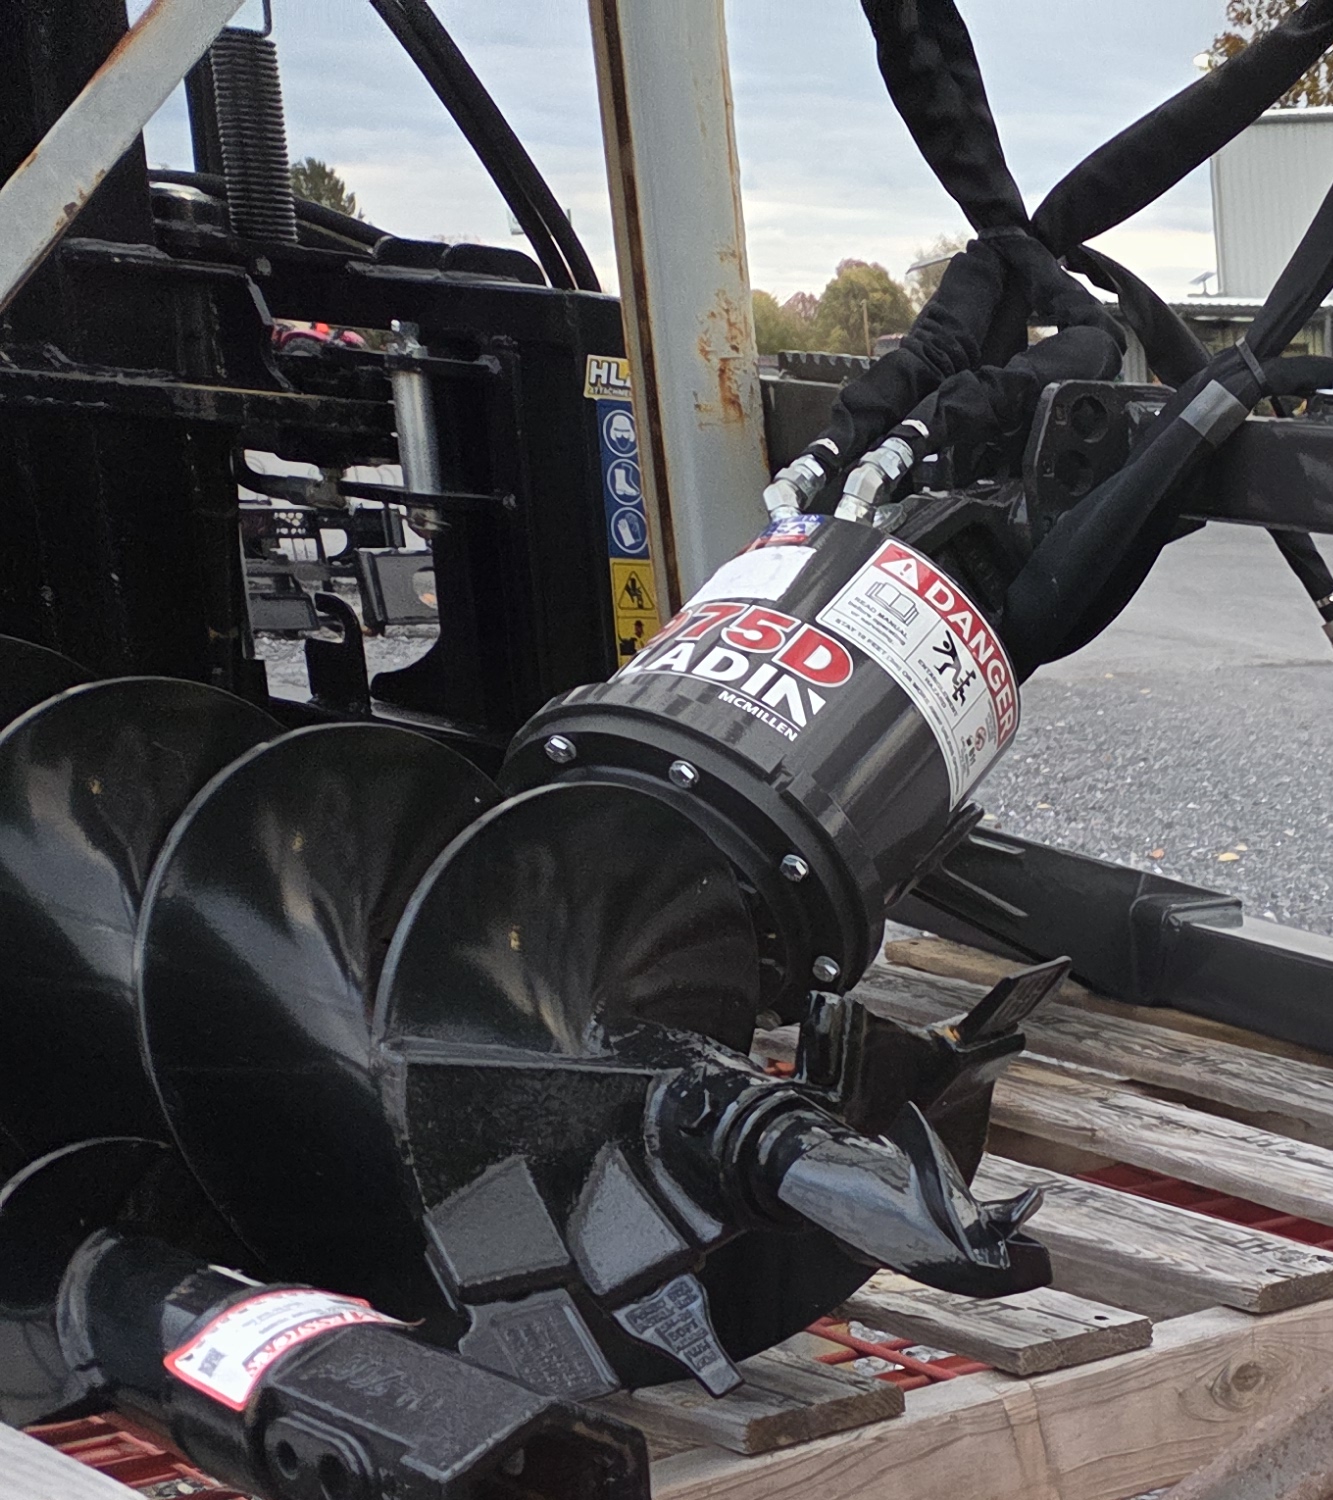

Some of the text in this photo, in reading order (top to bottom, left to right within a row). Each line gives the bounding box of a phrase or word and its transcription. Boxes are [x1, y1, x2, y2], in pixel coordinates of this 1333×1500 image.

[854, 597, 909, 640] READ MANUAL
[835, 618, 857, 633] STAY
[867, 638, 887, 655] FEET
[902, 670, 913, 682] OR
[912, 682, 930, 704] MORE
[918, 659, 958, 717] ENTANGLEMENT
[924, 580, 1016, 743] DANGER
[718, 690, 799, 742] MCMILLEN
[924, 678, 947, 709] HAZARD
